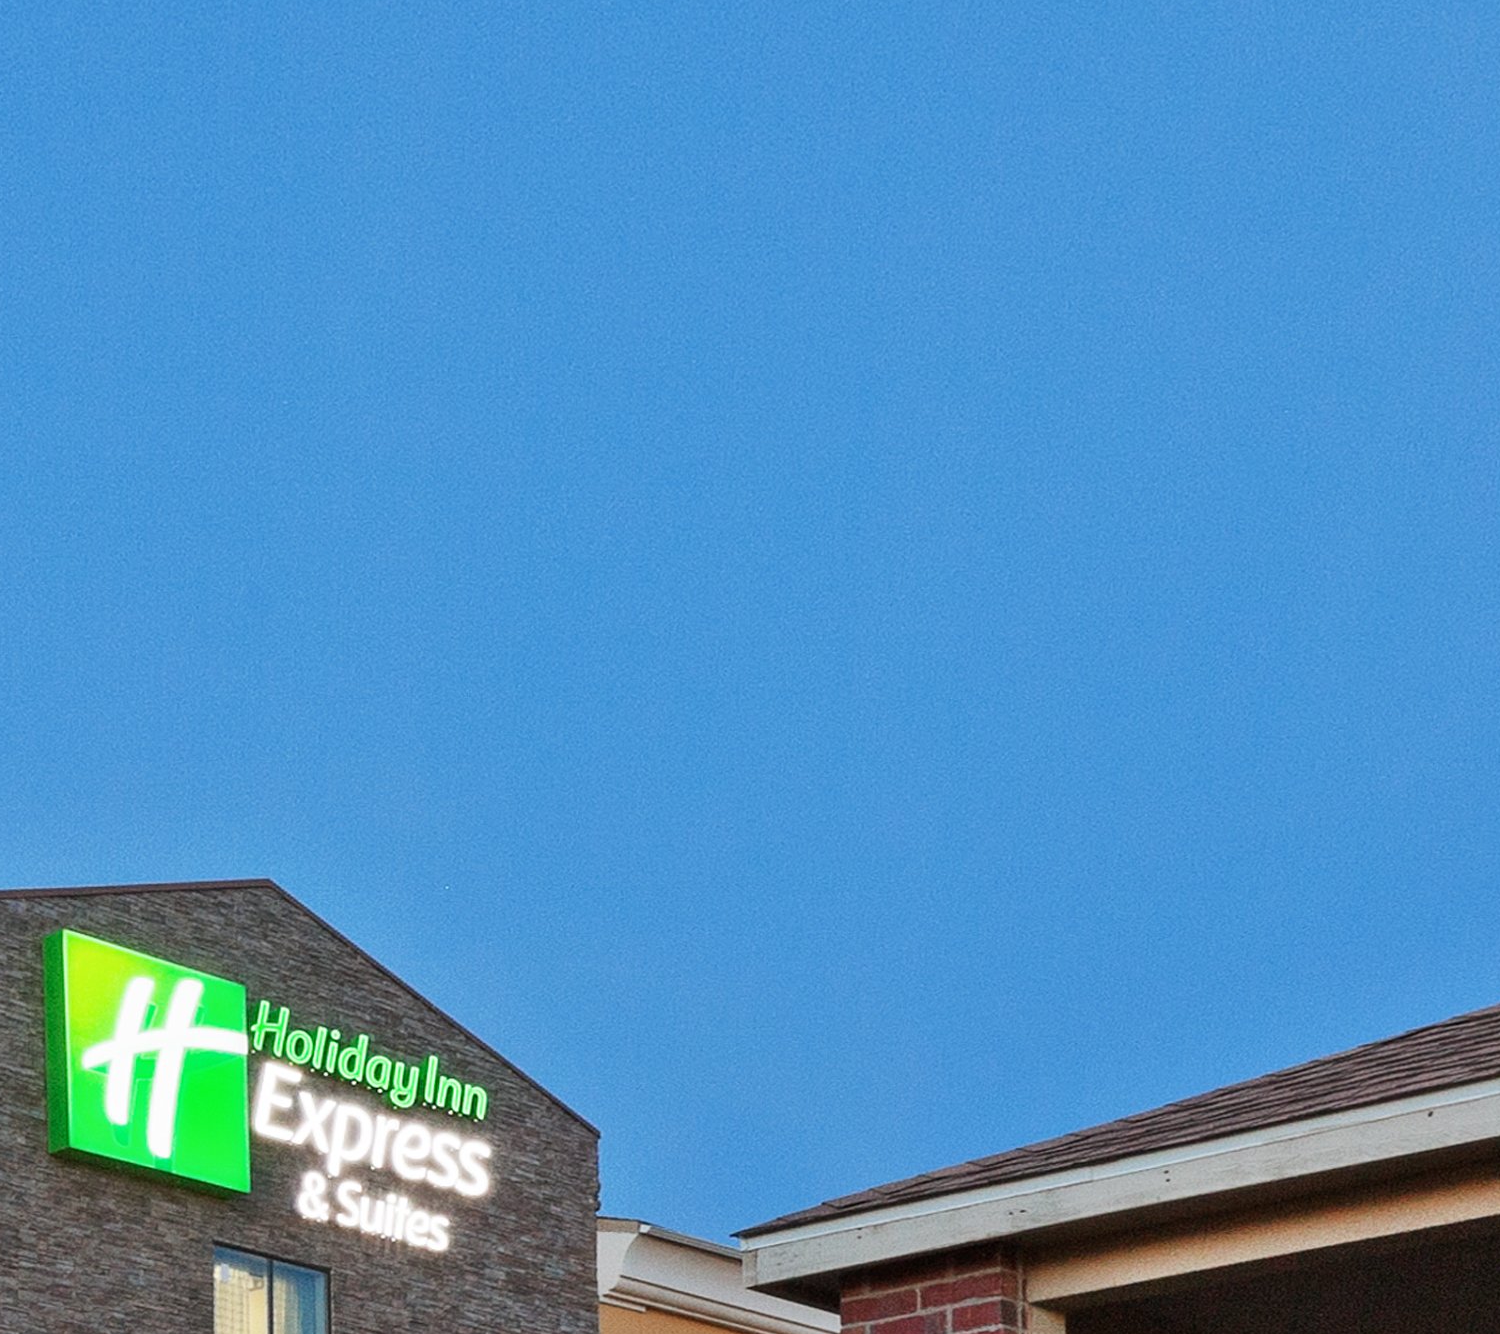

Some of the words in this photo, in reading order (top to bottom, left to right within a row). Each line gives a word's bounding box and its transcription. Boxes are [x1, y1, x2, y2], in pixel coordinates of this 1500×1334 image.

[81, 975, 248, 1159] H
[250, 999, 420, 1109] Holiday
[423, 1054, 488, 1121] Inn
[252, 1061, 493, 1198] Express
[296, 1170, 330, 1222] &
[334, 1179, 451, 1252] Suites
